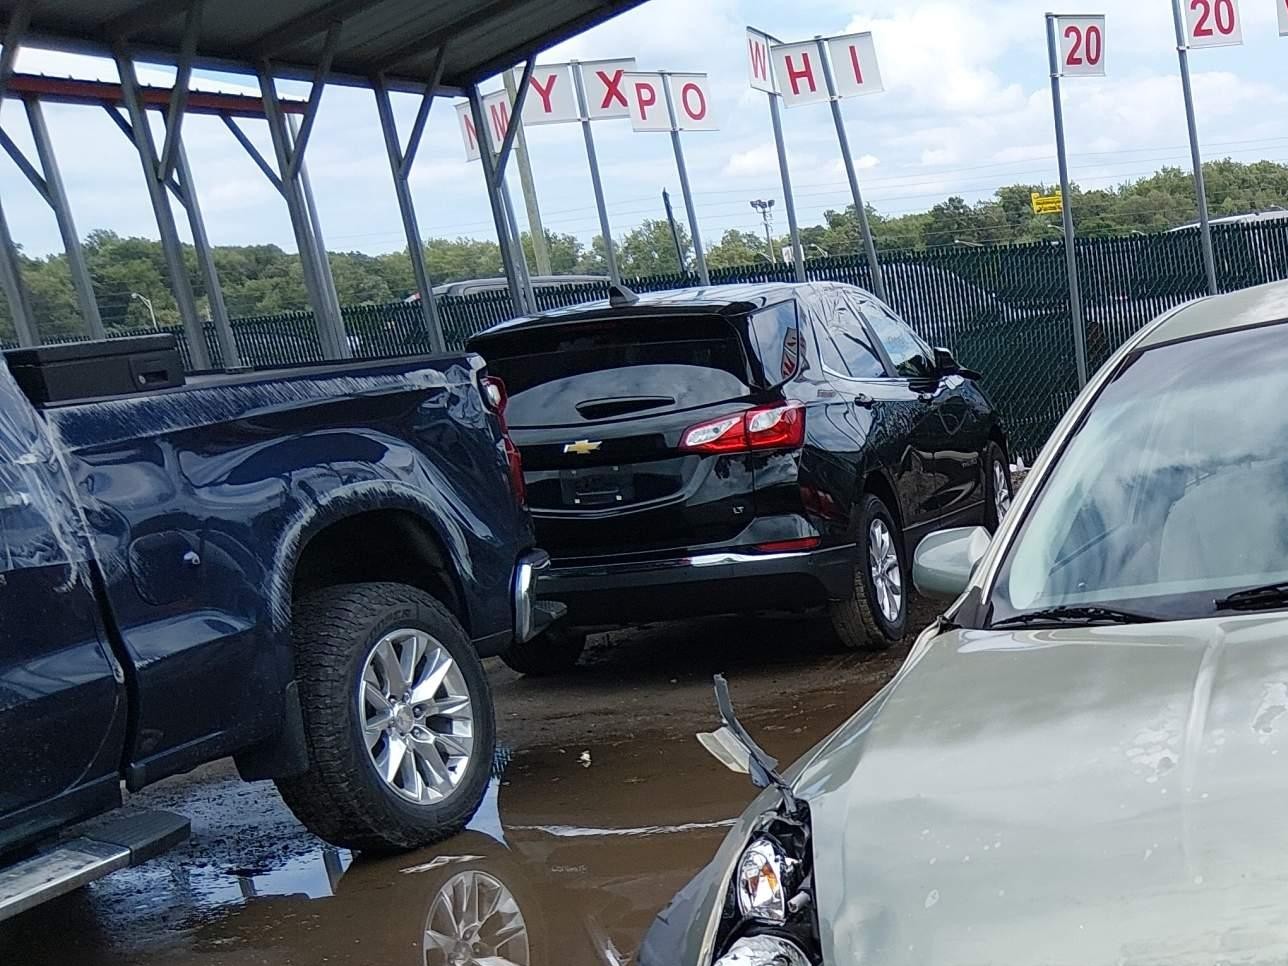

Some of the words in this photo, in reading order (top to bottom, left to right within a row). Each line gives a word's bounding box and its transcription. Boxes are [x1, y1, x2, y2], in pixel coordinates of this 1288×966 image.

[1190, 0, 1235, 37] 20
[748, 38, 767, 81] W
[1064, 26, 1102, 66] 20
[785, 53, 817, 95] H
[849, 45, 863, 84] I
[529, 74, 558, 113] Y
[596, 69, 629, 109] X
[635, 83, 656, 120] P
